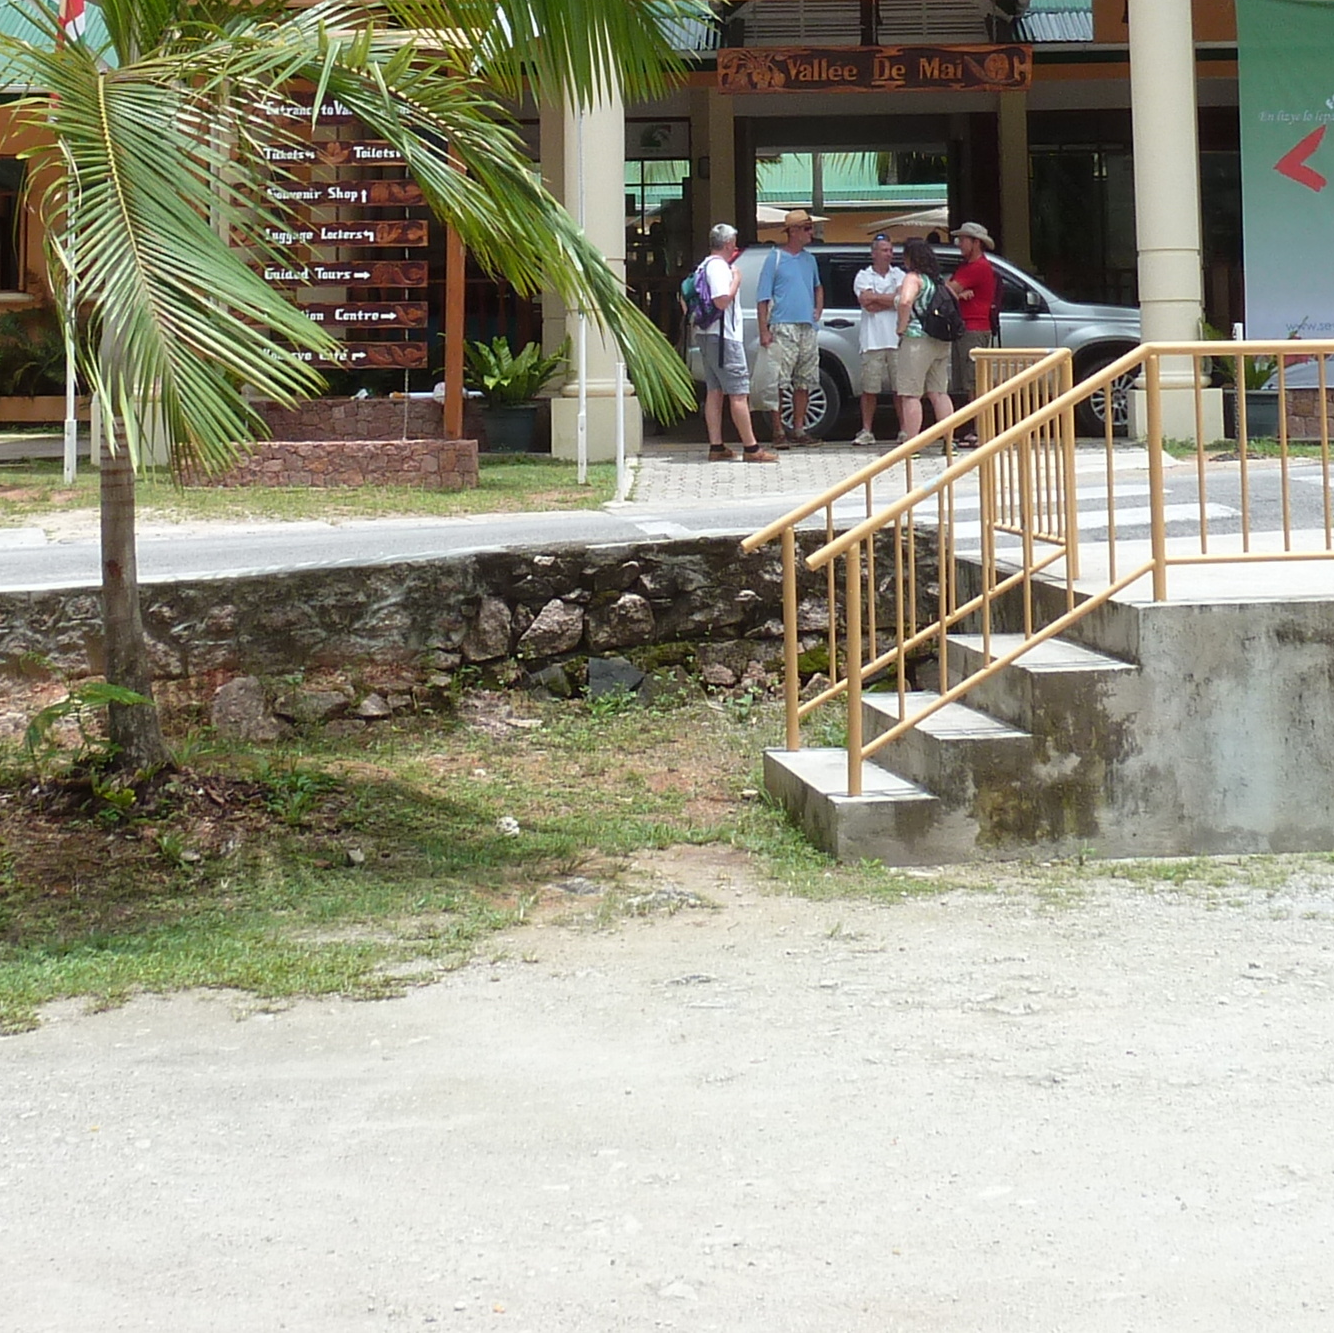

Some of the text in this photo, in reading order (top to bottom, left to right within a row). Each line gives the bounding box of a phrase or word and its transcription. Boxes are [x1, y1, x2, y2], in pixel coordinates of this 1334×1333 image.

[785, 57, 964, 81] Vallée De Mai
[353, 146, 394, 158] Toilets
[328, 187, 358, 202] Shop
[314, 267, 352, 279] Tours
[335, 309, 379, 320] Centre
